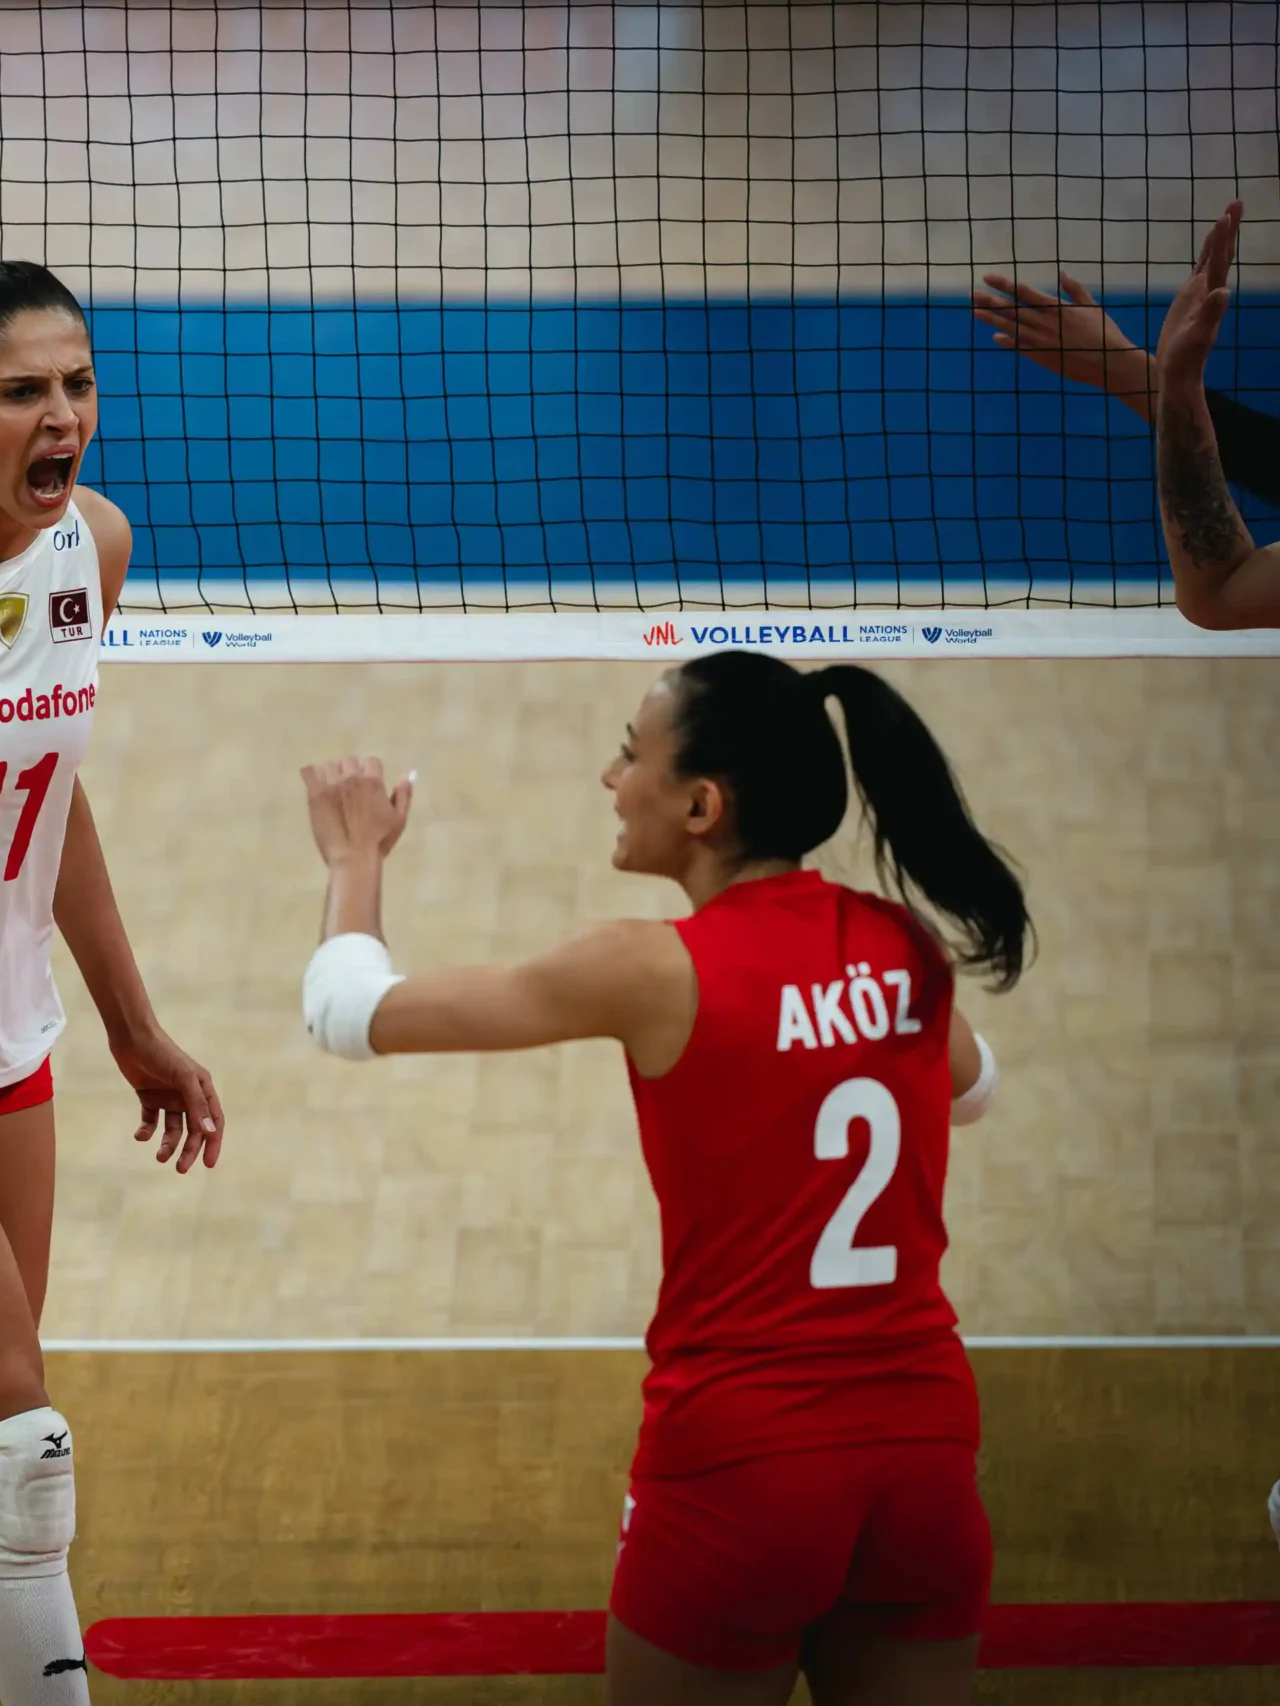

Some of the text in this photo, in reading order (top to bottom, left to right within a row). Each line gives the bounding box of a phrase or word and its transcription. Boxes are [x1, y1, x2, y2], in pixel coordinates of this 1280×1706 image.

[61, 626, 84, 638] TUR
[139, 629, 188, 638] NATIONS
[643, 621, 854, 646] VNL VOLLEYBALL
[859, 625, 908, 635] NATIONS
[945, 628, 993, 638] Volleyball
[225, 633, 272, 642] Volleyball
[776, 961, 922, 1051] AKÖZ
[810, 1076, 901, 1289] 2
